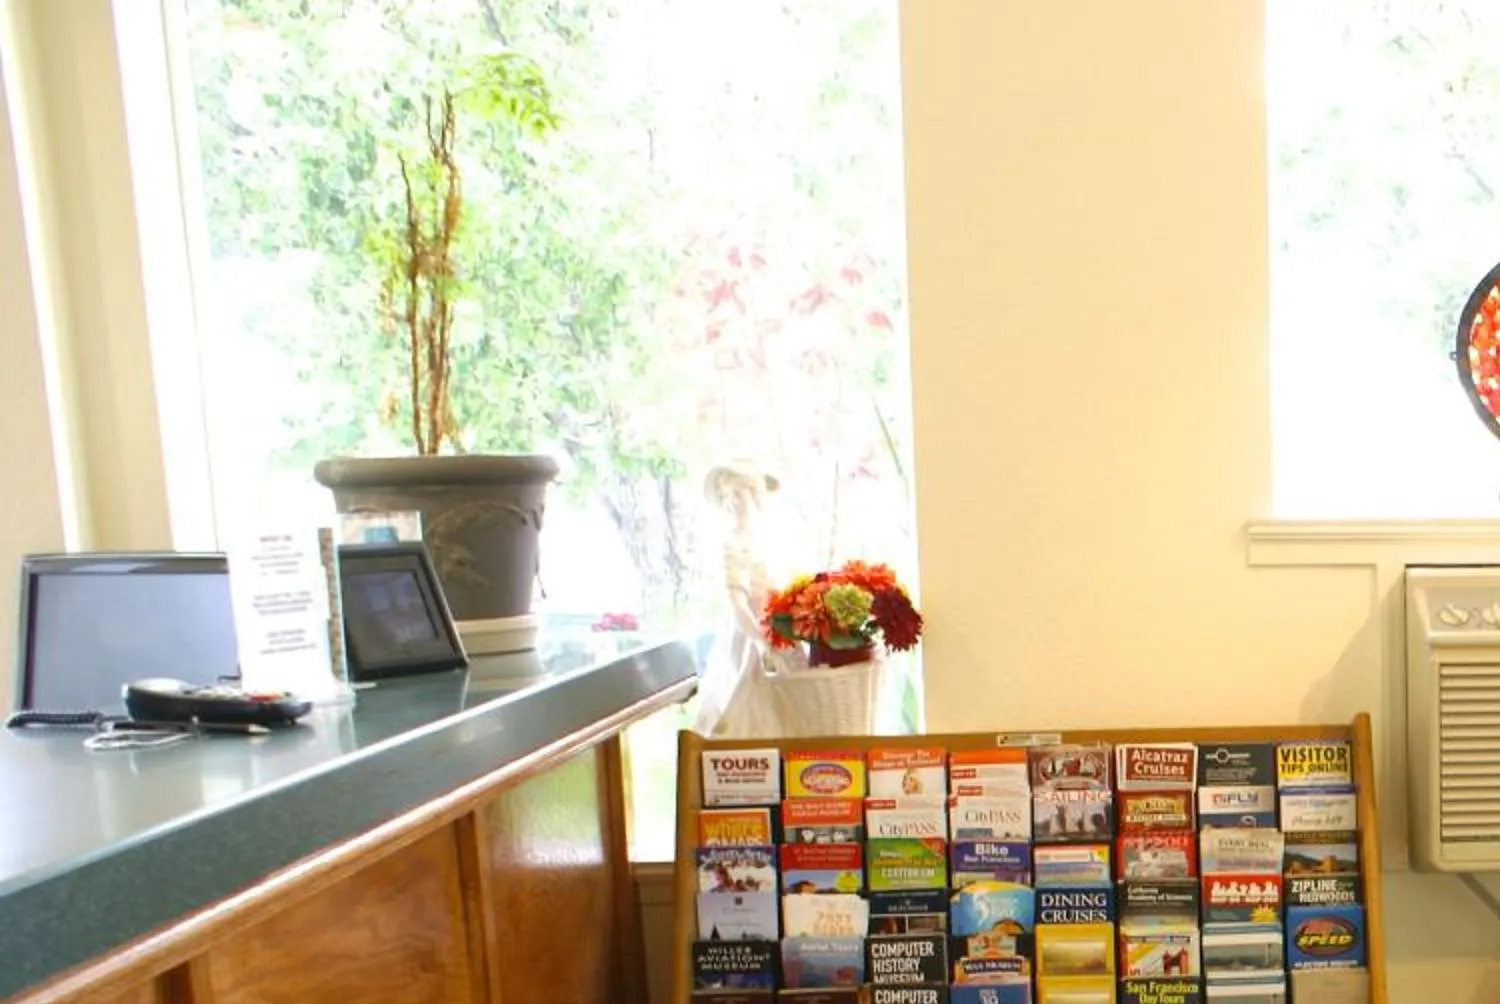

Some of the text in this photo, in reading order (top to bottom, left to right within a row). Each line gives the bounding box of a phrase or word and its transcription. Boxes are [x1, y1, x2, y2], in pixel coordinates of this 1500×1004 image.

[1131, 750, 1188, 764] Alcatraz
[1281, 747, 1348, 763] VISITOR
[710, 758, 769, 770] TOURS
[1134, 762, 1185, 775] Cruises
[1281, 762, 1348, 773] TIPS ONLINE
[965, 808, 1022, 823] CityPASS
[975, 843, 1009, 856] Bike
[1292, 879, 1338, 893] ZIPLINE
[1041, 893, 1107, 907] DINING
[1041, 909, 1107, 923] CRUISES
[871, 942, 935, 957] COMPUTER
[873, 958, 920, 973] HISTORY
[1127, 981, 1199, 995] San Francisco
[875, 989, 938, 1004] COMPUTER
